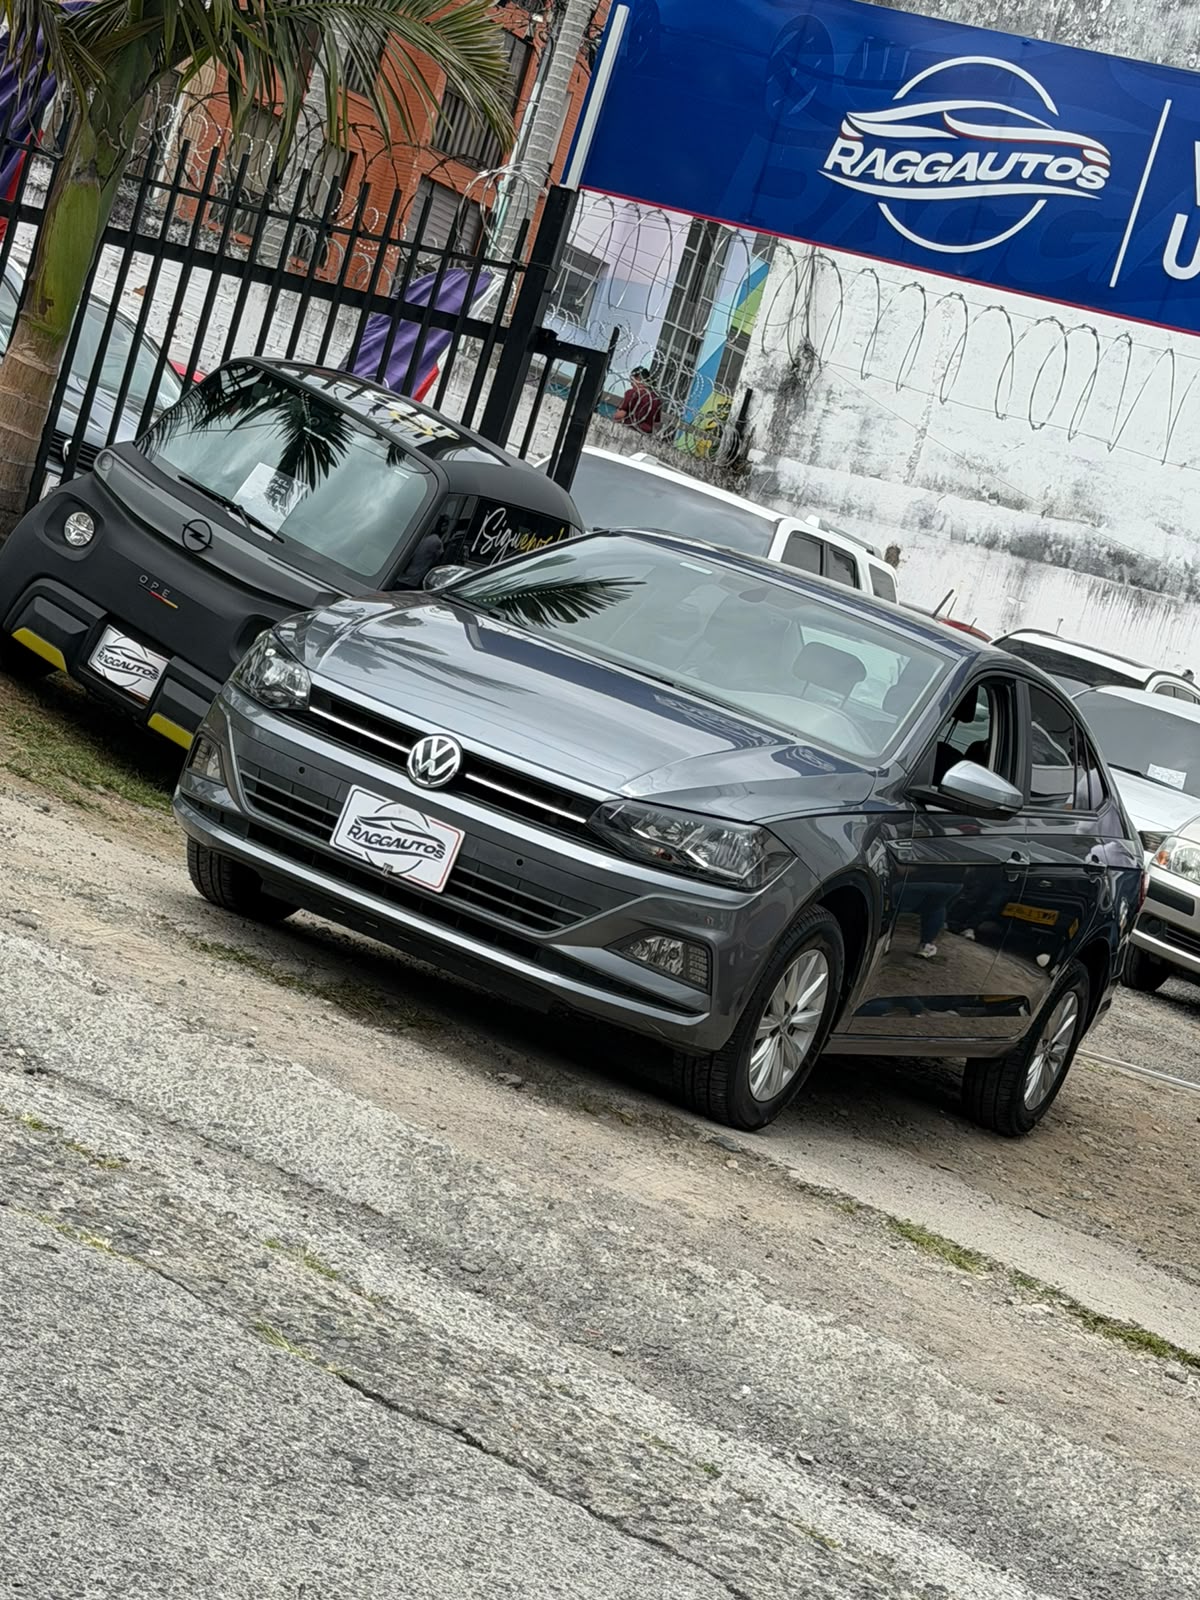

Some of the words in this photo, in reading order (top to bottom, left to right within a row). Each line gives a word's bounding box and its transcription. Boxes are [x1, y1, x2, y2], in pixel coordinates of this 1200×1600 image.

[822, 138, 1111, 191] RAGGAUTOS
[97, 650, 159, 680] RAGGAUTOS
[346, 824, 446, 860] RAGGAUTOS
